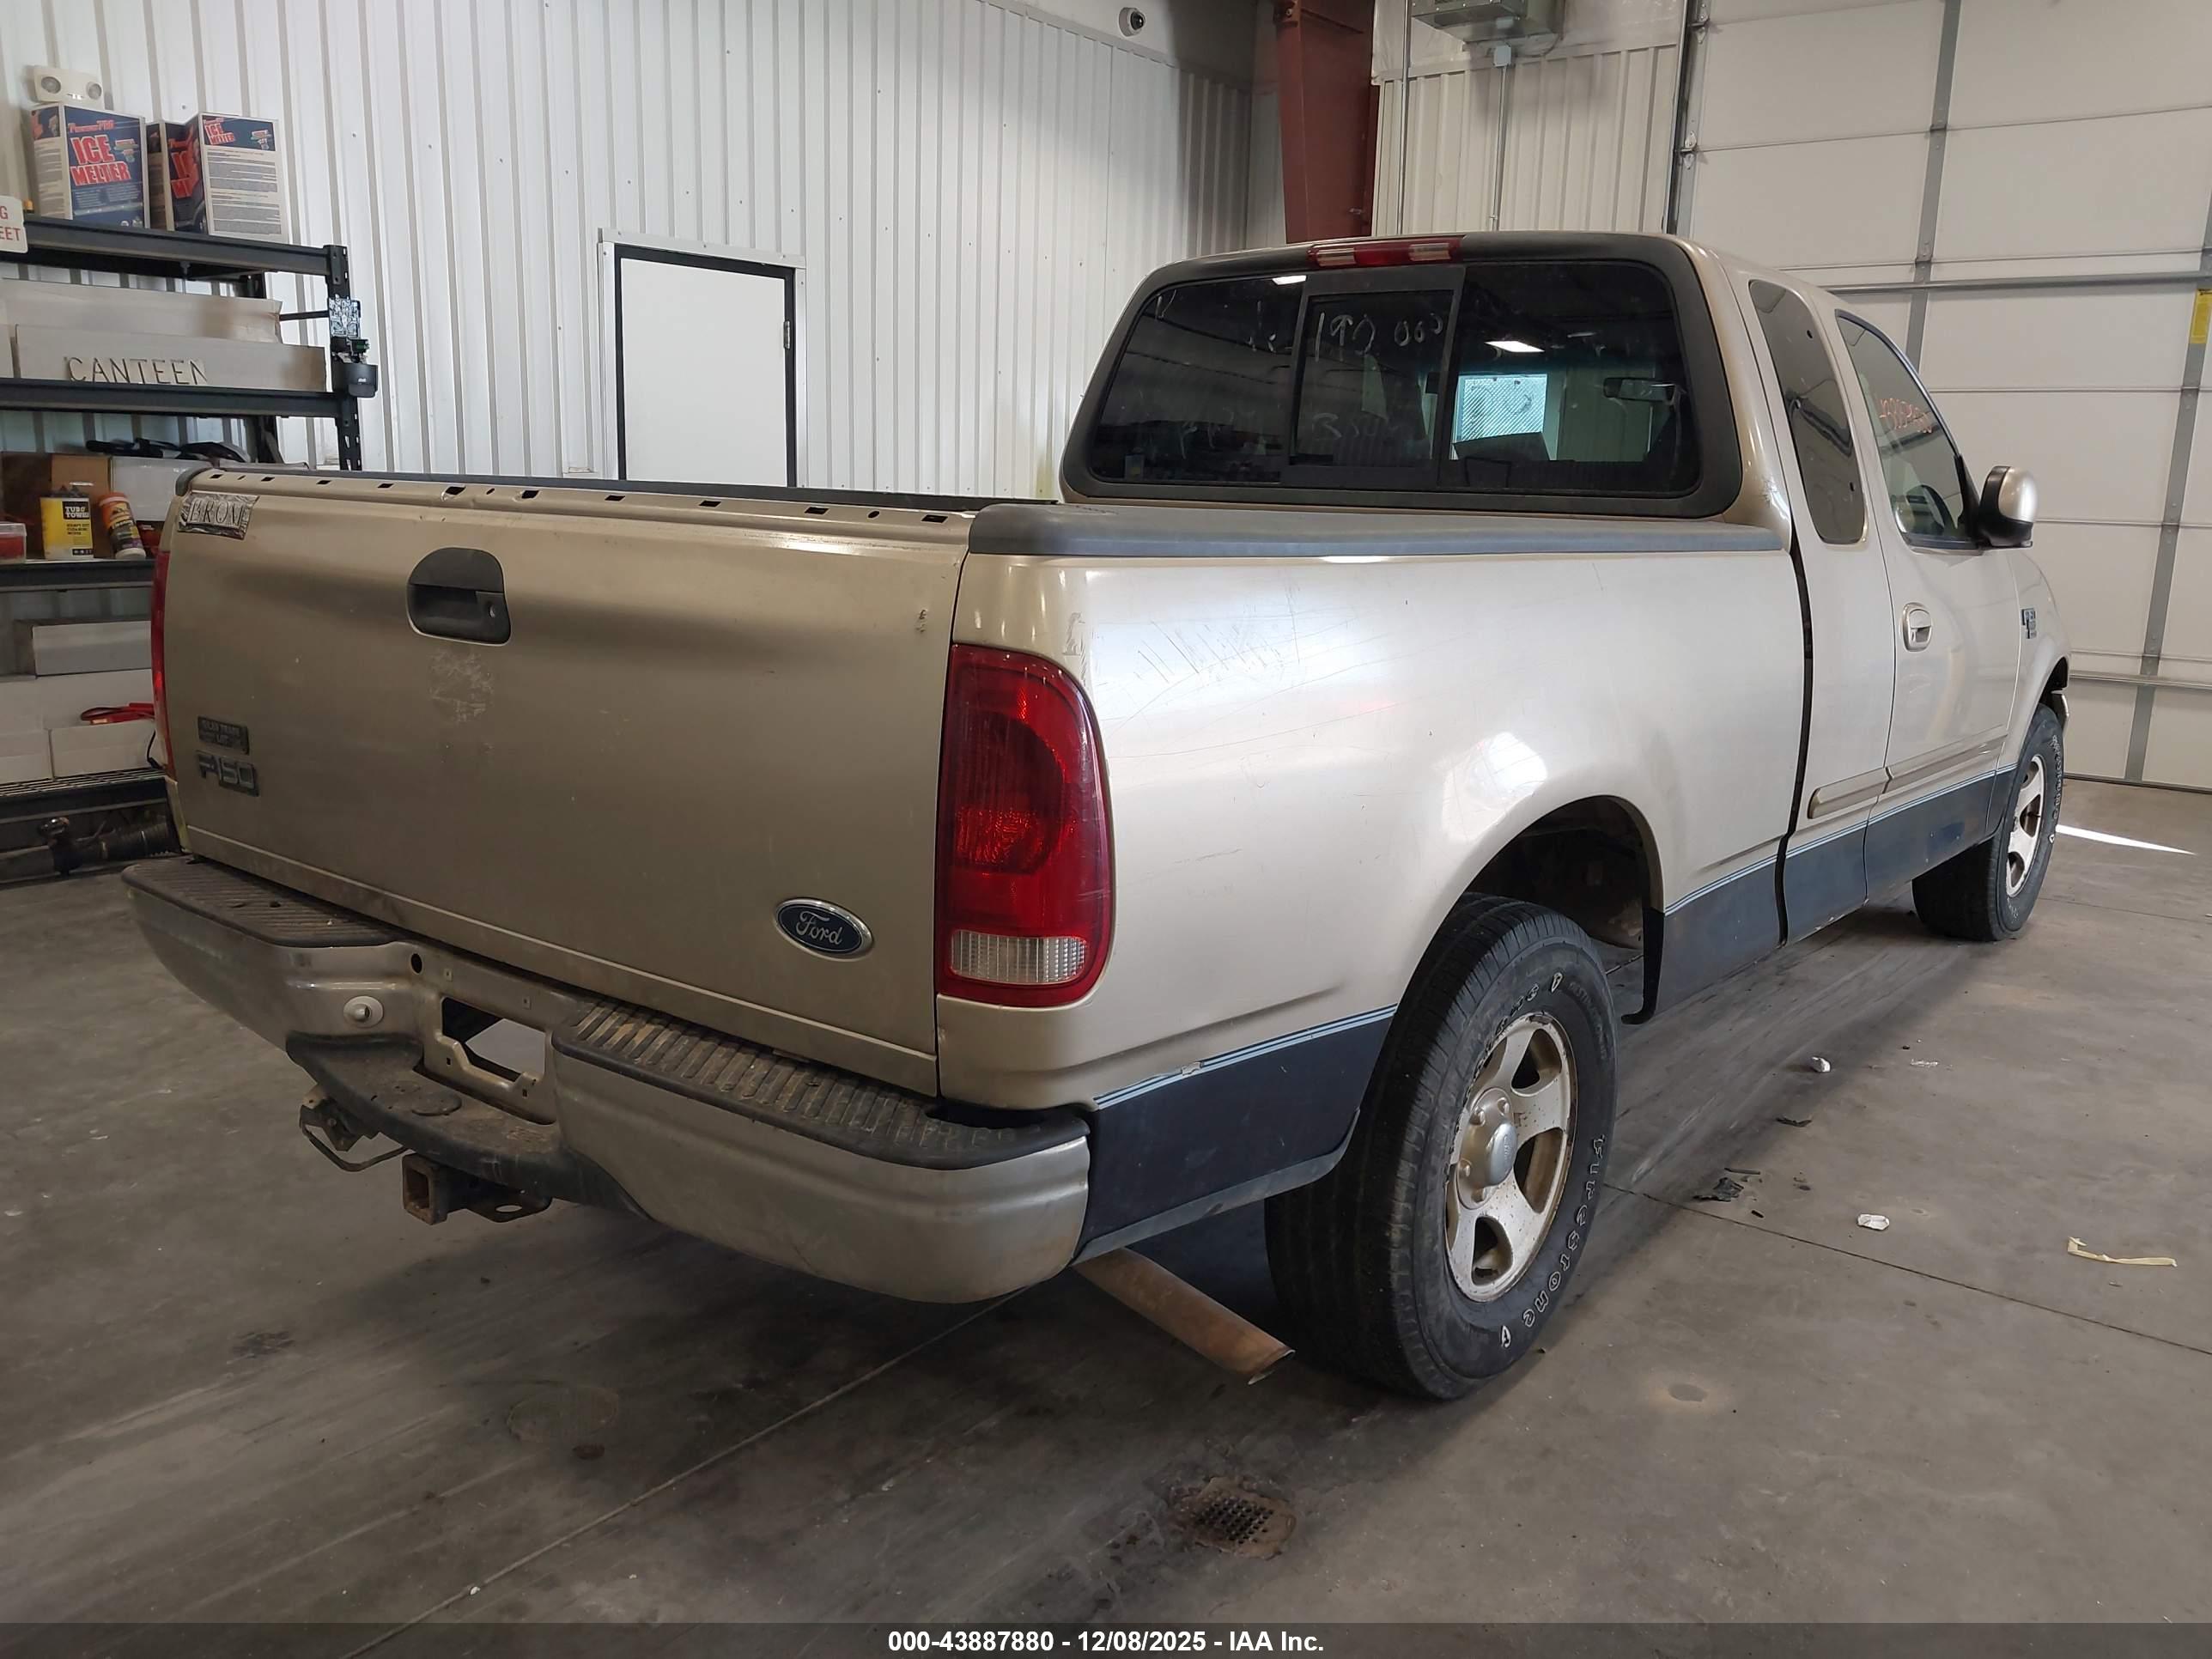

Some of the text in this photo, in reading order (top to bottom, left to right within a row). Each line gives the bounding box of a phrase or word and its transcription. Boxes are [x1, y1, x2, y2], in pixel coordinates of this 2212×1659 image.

[70, 134, 115, 165] ICE
[70, 161, 131, 186] MELTER
[68, 356, 207, 385] CANTEEN
[795, 910, 842, 945] Ford
